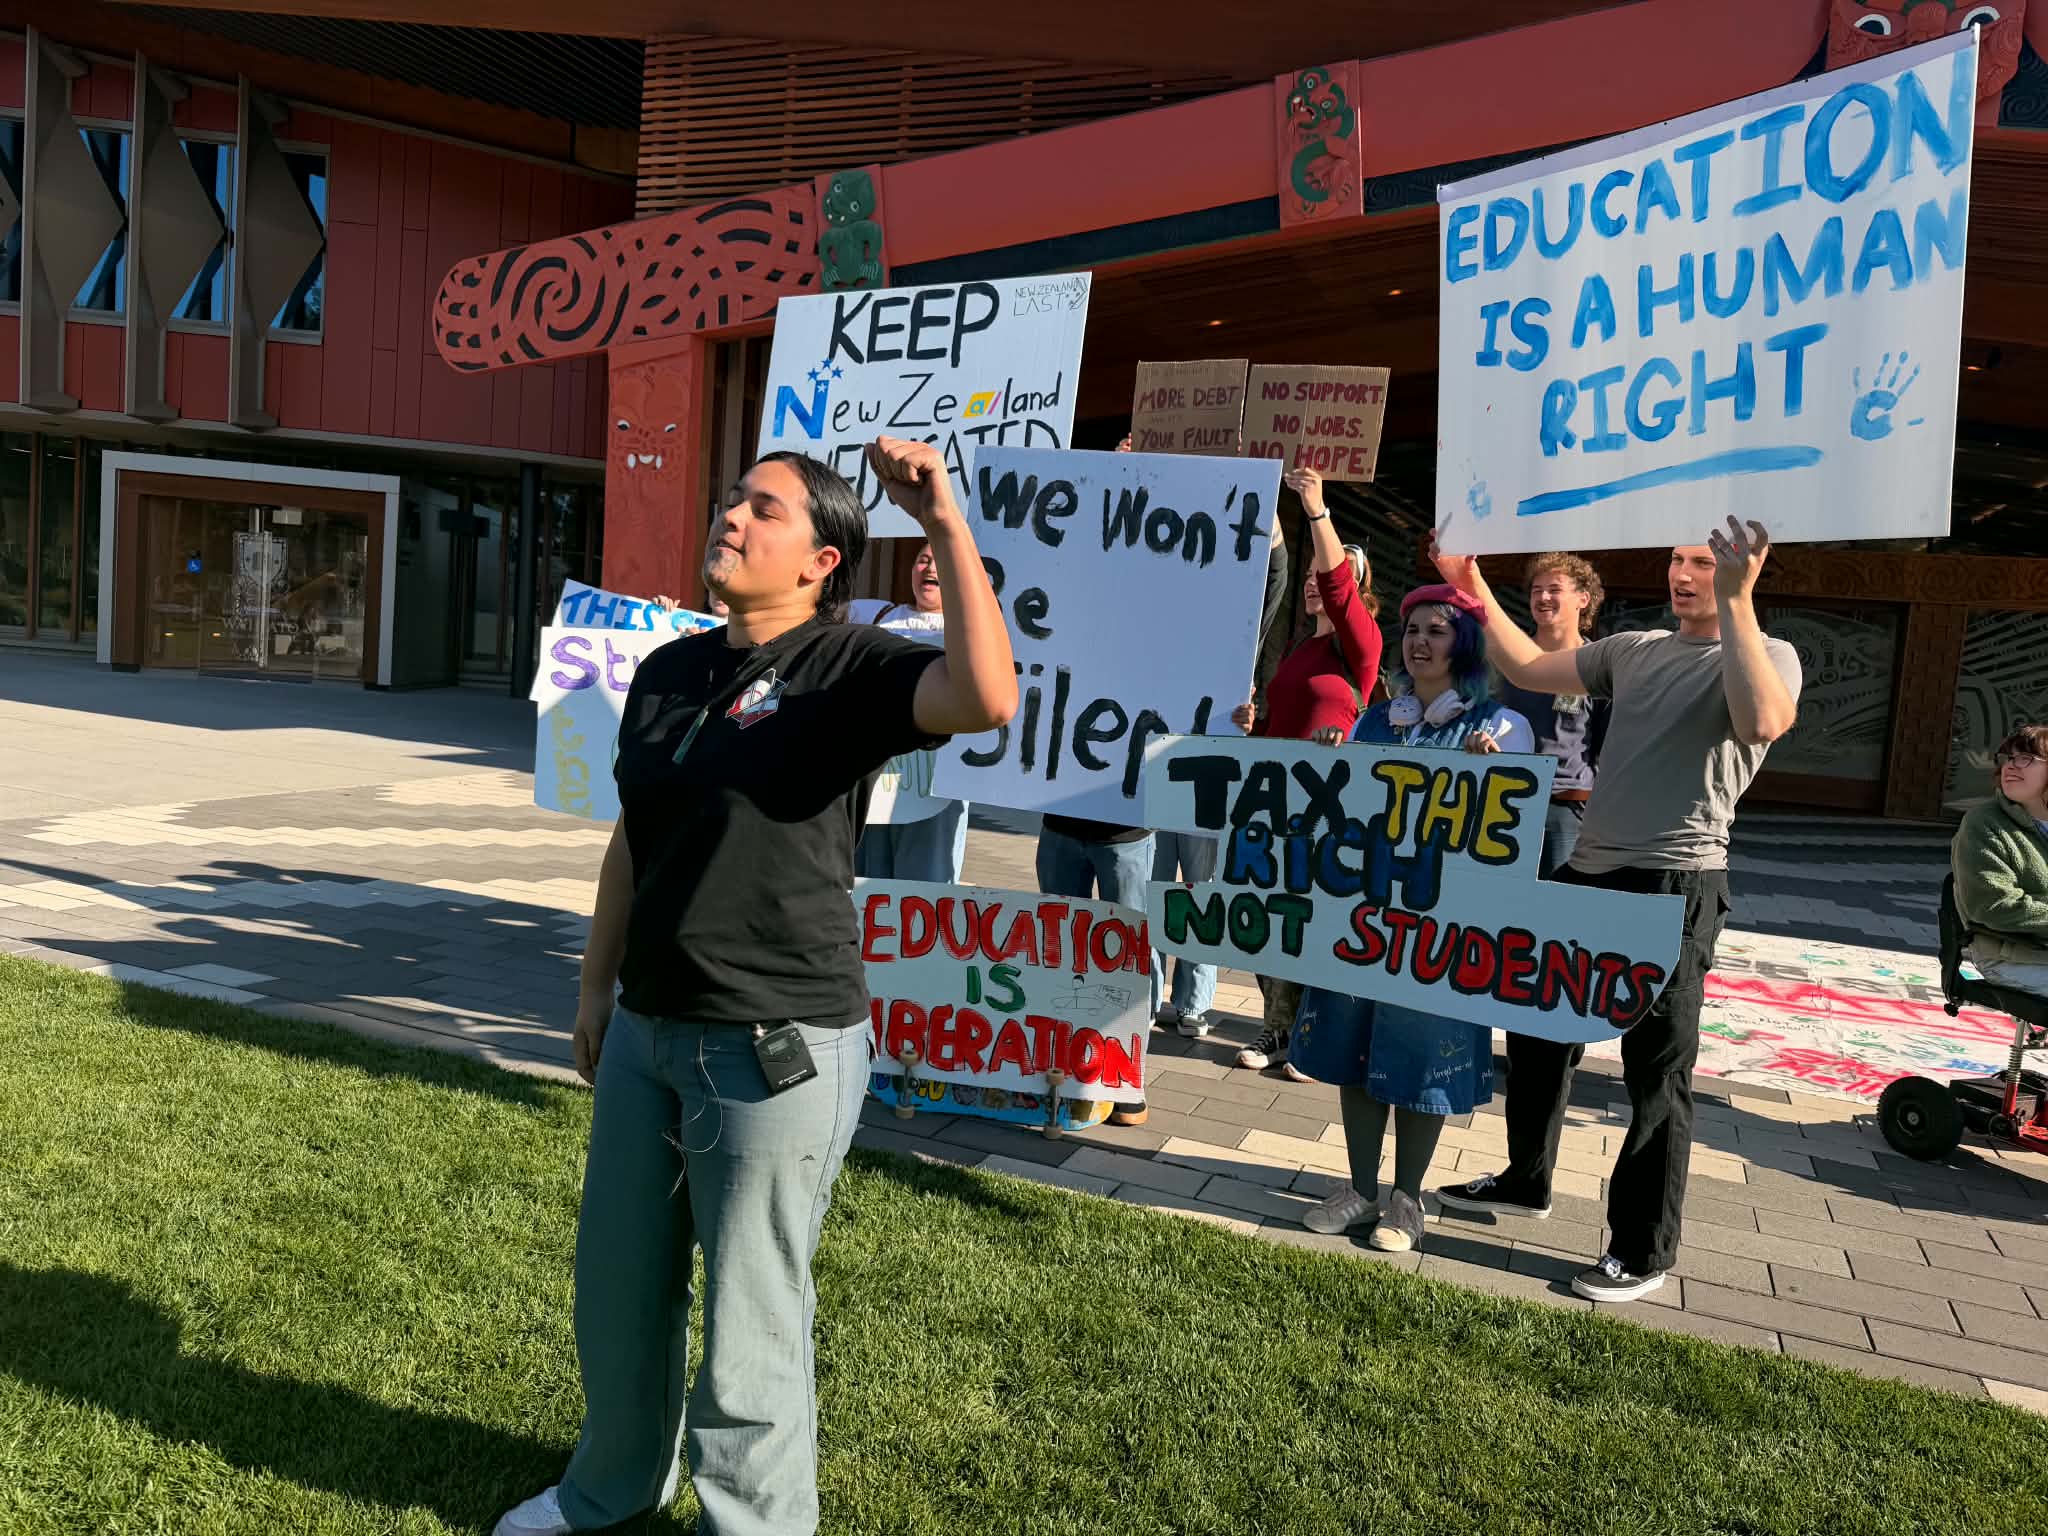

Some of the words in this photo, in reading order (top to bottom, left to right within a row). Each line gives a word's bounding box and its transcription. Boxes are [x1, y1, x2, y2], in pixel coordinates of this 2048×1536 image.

[1446, 47, 1976, 283] EDUCATION
[1475, 297, 1552, 372] IS
[1570, 274, 1616, 349] A
[1637, 187, 1967, 338] HUMAN
[828, 281, 1000, 368] KEEP
[1138, 387, 1184, 411] MORE
[1193, 385, 1240, 408] DEBT
[1262, 382, 1289, 400] NO
[1273, 414, 1300, 434] NO
[1305, 415, 1363, 438] JOBS.
[1540, 323, 1829, 458] RIGHT
[1139, 427, 1175, 450] YOUR
[1184, 427, 1235, 449] FAULT
[1294, 444, 1372, 475] HOPE.
[563, 589, 666, 632] THIS
[1167, 755, 1351, 839] TAX
[1371, 760, 1538, 866] THE
[861, 893, 1150, 976] EDUCATION
[1163, 888, 1313, 957] NOT
[1333, 902, 1665, 1030] STUDENTS
[966, 964, 1026, 1013] IS
[870, 997, 1142, 1089] IBERATION
